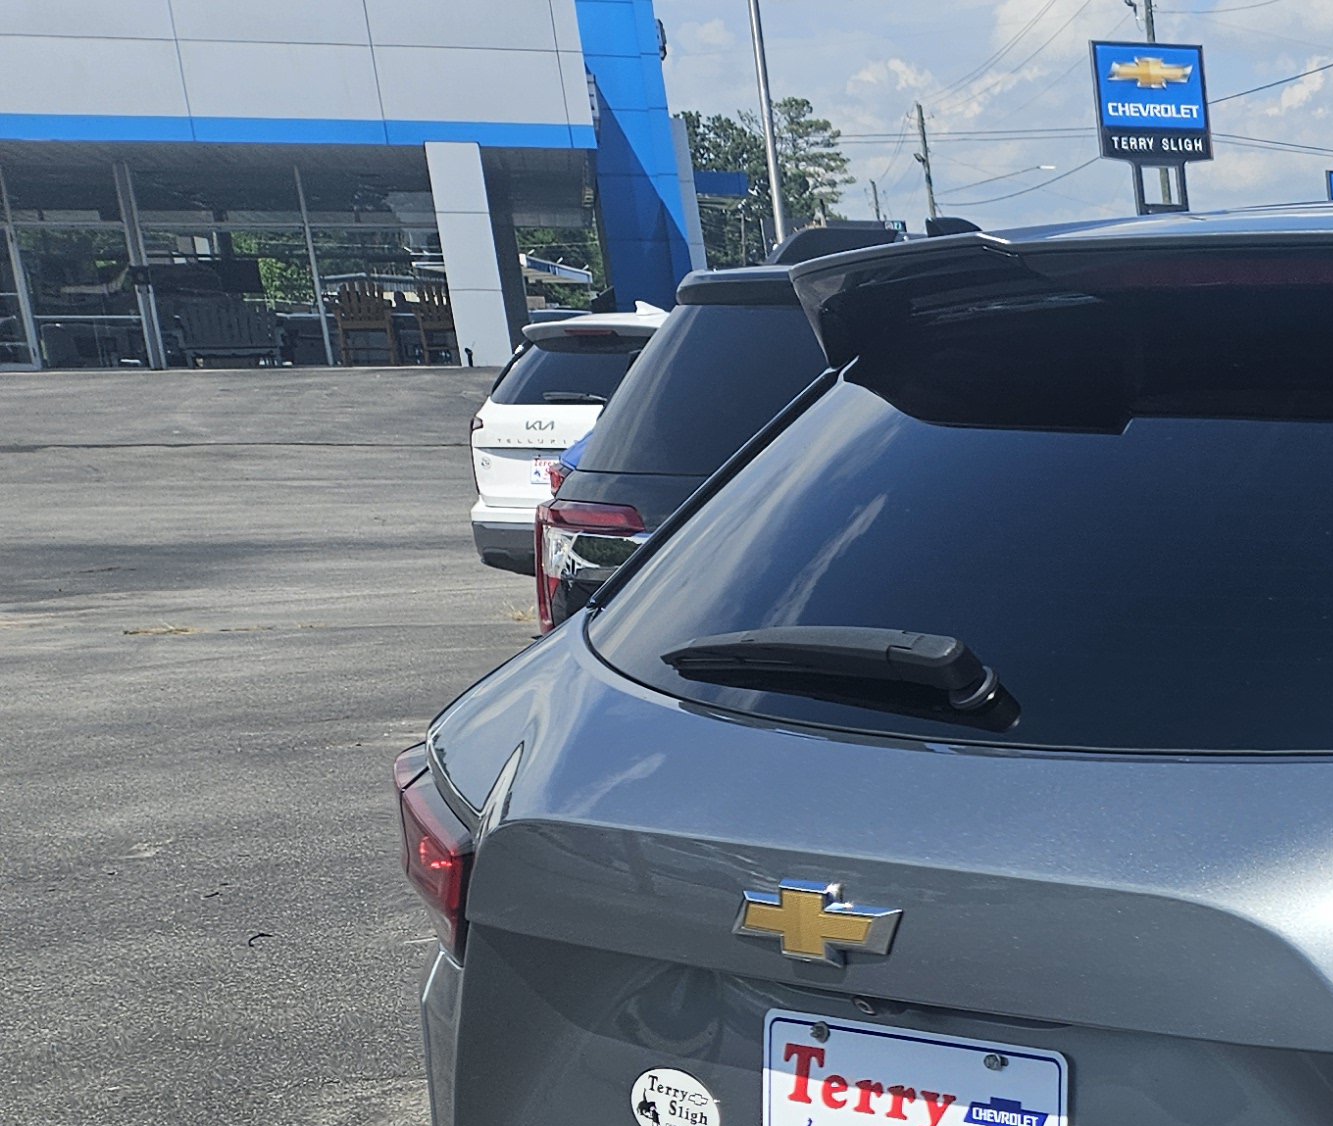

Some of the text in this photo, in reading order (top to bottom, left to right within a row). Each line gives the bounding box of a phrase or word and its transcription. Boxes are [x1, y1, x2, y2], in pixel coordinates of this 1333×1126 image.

[1107, 102, 1199, 119] CHEVROLET
[1111, 136, 1203, 152] TERRY SLIGH
[525, 420, 555, 431] KIA
[497, 438, 580, 446] TELLURI
[648, 1075, 688, 1102] Terry
[669, 1100, 708, 1125] Sligh
